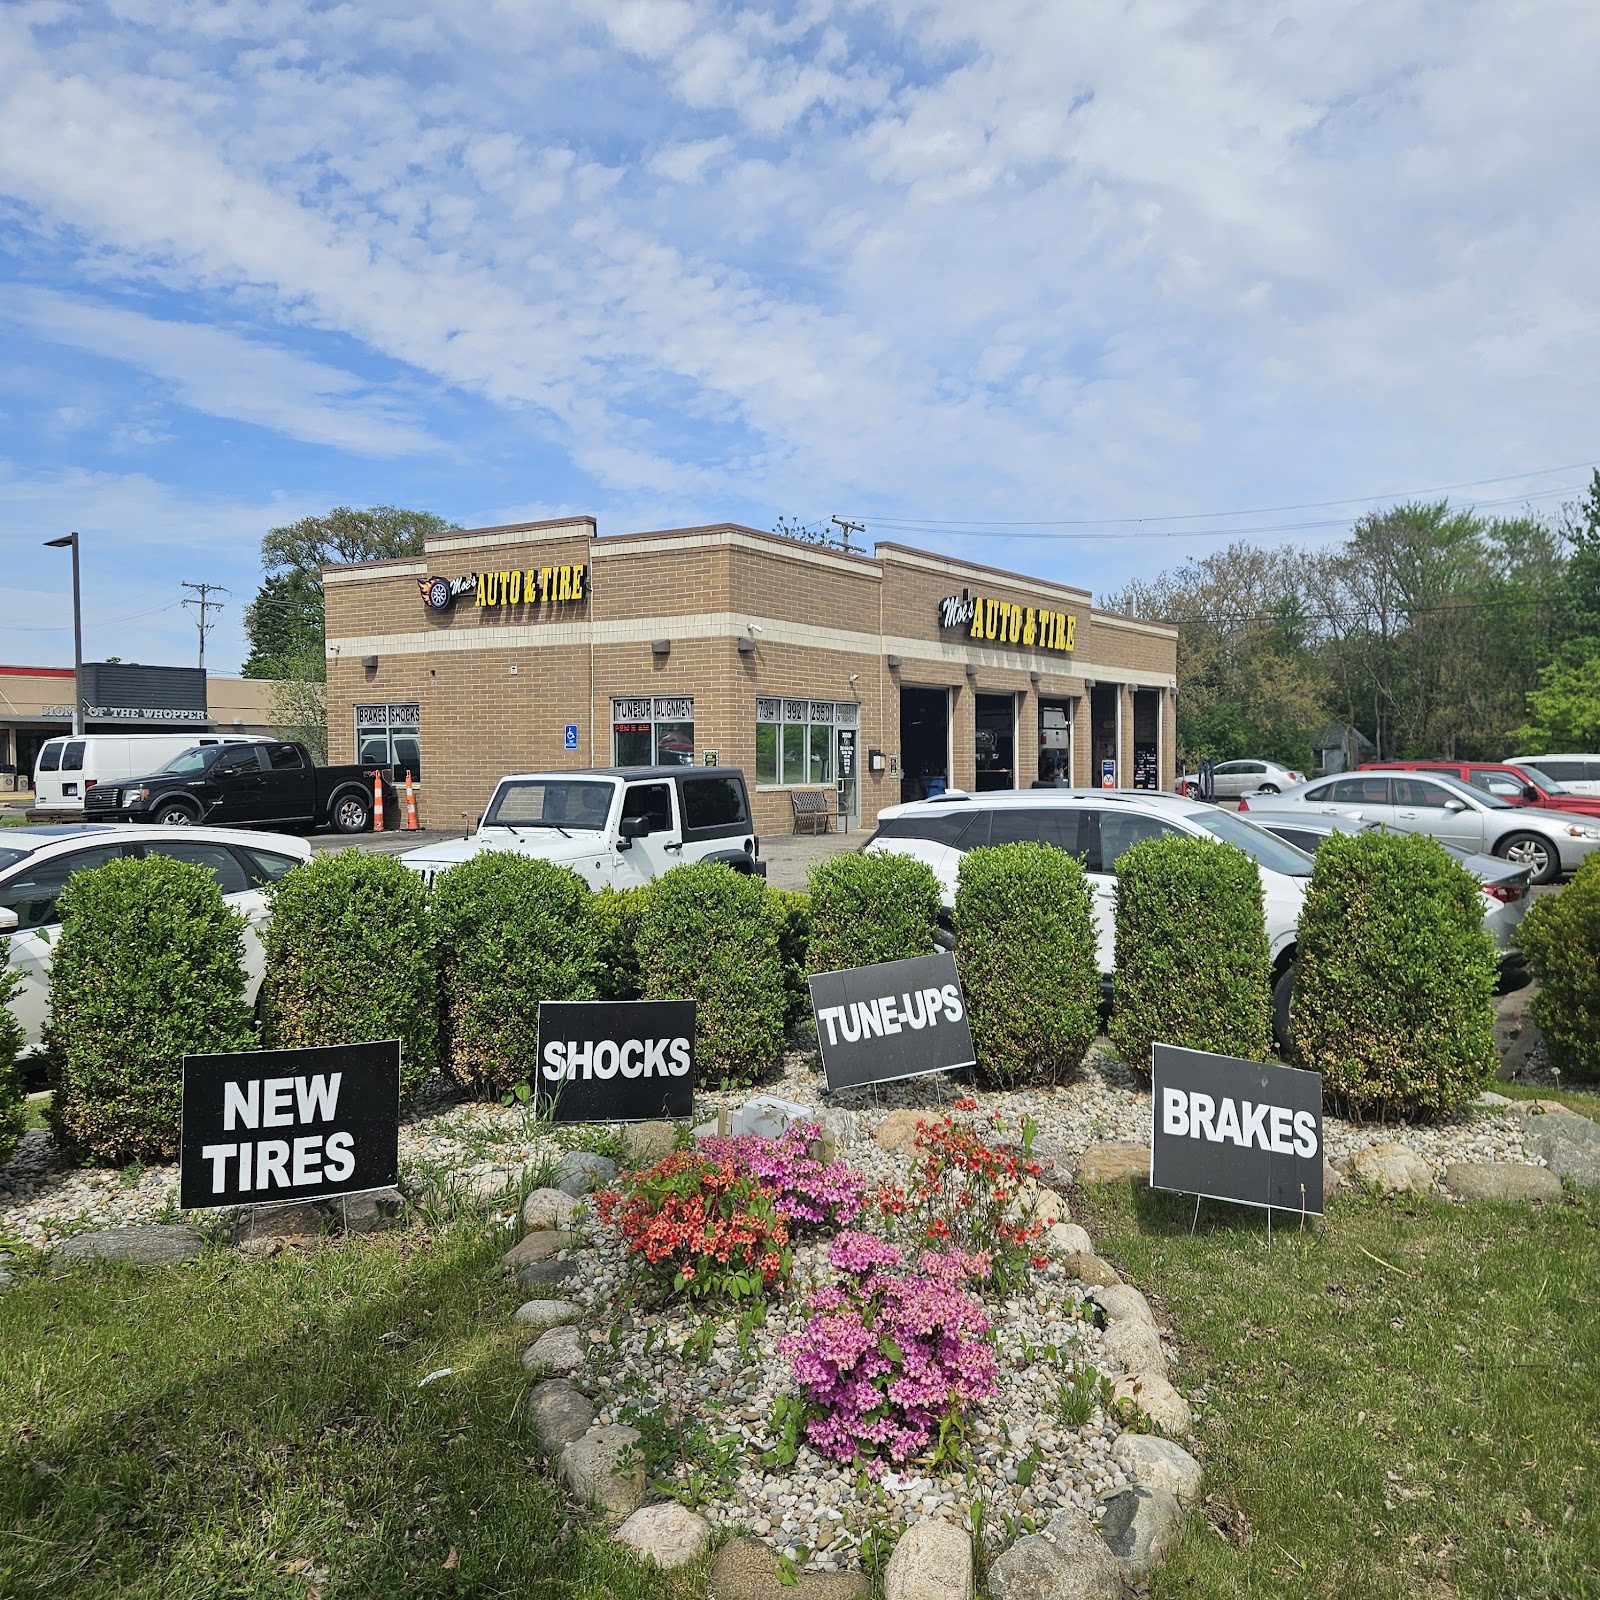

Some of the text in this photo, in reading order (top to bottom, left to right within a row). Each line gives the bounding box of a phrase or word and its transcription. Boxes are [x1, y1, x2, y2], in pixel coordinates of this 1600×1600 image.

[450, 564, 585, 607] Moe's AUTO & TIRE
[970, 597, 1021, 644] AUTO
[1022, 607, 1035, 646] &
[1038, 609, 1077, 652] TIRE
[41, 705, 205, 720] HOM OF THE WHOPPER
[359, 707, 419, 723] BRAKES SHOCKS
[615, 700, 694, 718] TUNE-UP ALIGNMENT
[758, 700, 774, 719] 734
[786, 702, 802, 720] 992
[811, 703, 830, 722] 2550
[818, 984, 963, 1046] TUNE-UPS
[542, 1037, 691, 1081] SHOCKS
[223, 1072, 342, 1131] NEW
[1163, 1087, 1318, 1159] BRAKES
[202, 1131, 356, 1194] TIRES
